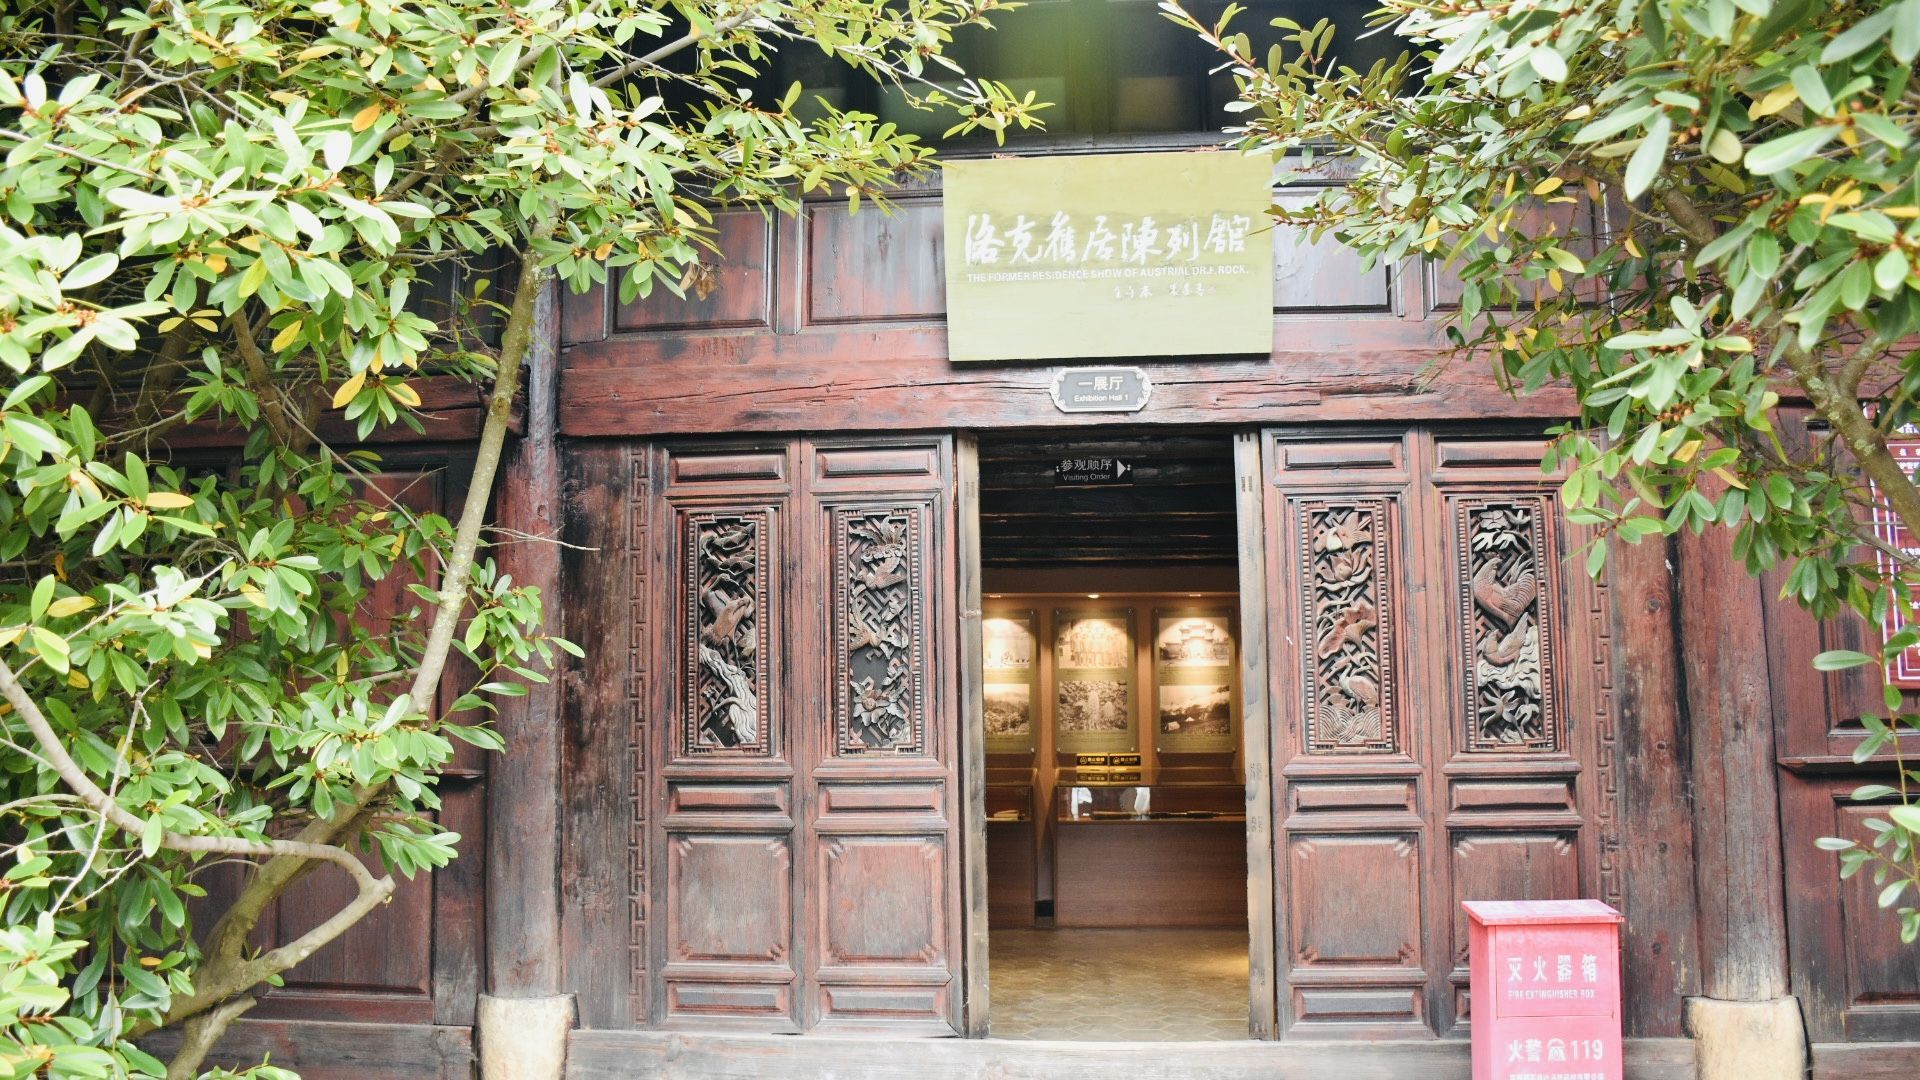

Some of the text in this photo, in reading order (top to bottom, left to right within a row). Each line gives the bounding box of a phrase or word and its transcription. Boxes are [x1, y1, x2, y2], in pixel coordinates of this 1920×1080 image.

[967, 273, 986, 283] THE
[988, 271, 1030, 282] FORMER
[1032, 269, 1089, 281] RESIDENCE
[1091, 268, 1121, 279] SHOW
[1124, 267, 1137, 278] OF
[1140, 266, 1189, 277] AUSTRIAL
[1078, 376, 1124, 391] 一展厅
[1074, 394, 1107, 402] Exhibition
[1061, 459, 1112, 472] 参观顺序
[1063, 473, 1110, 482] Visiting Order
[1507, 954, 1598, 983] 灭火器箱
[1508, 1038, 1604, 1062] 火警 119
